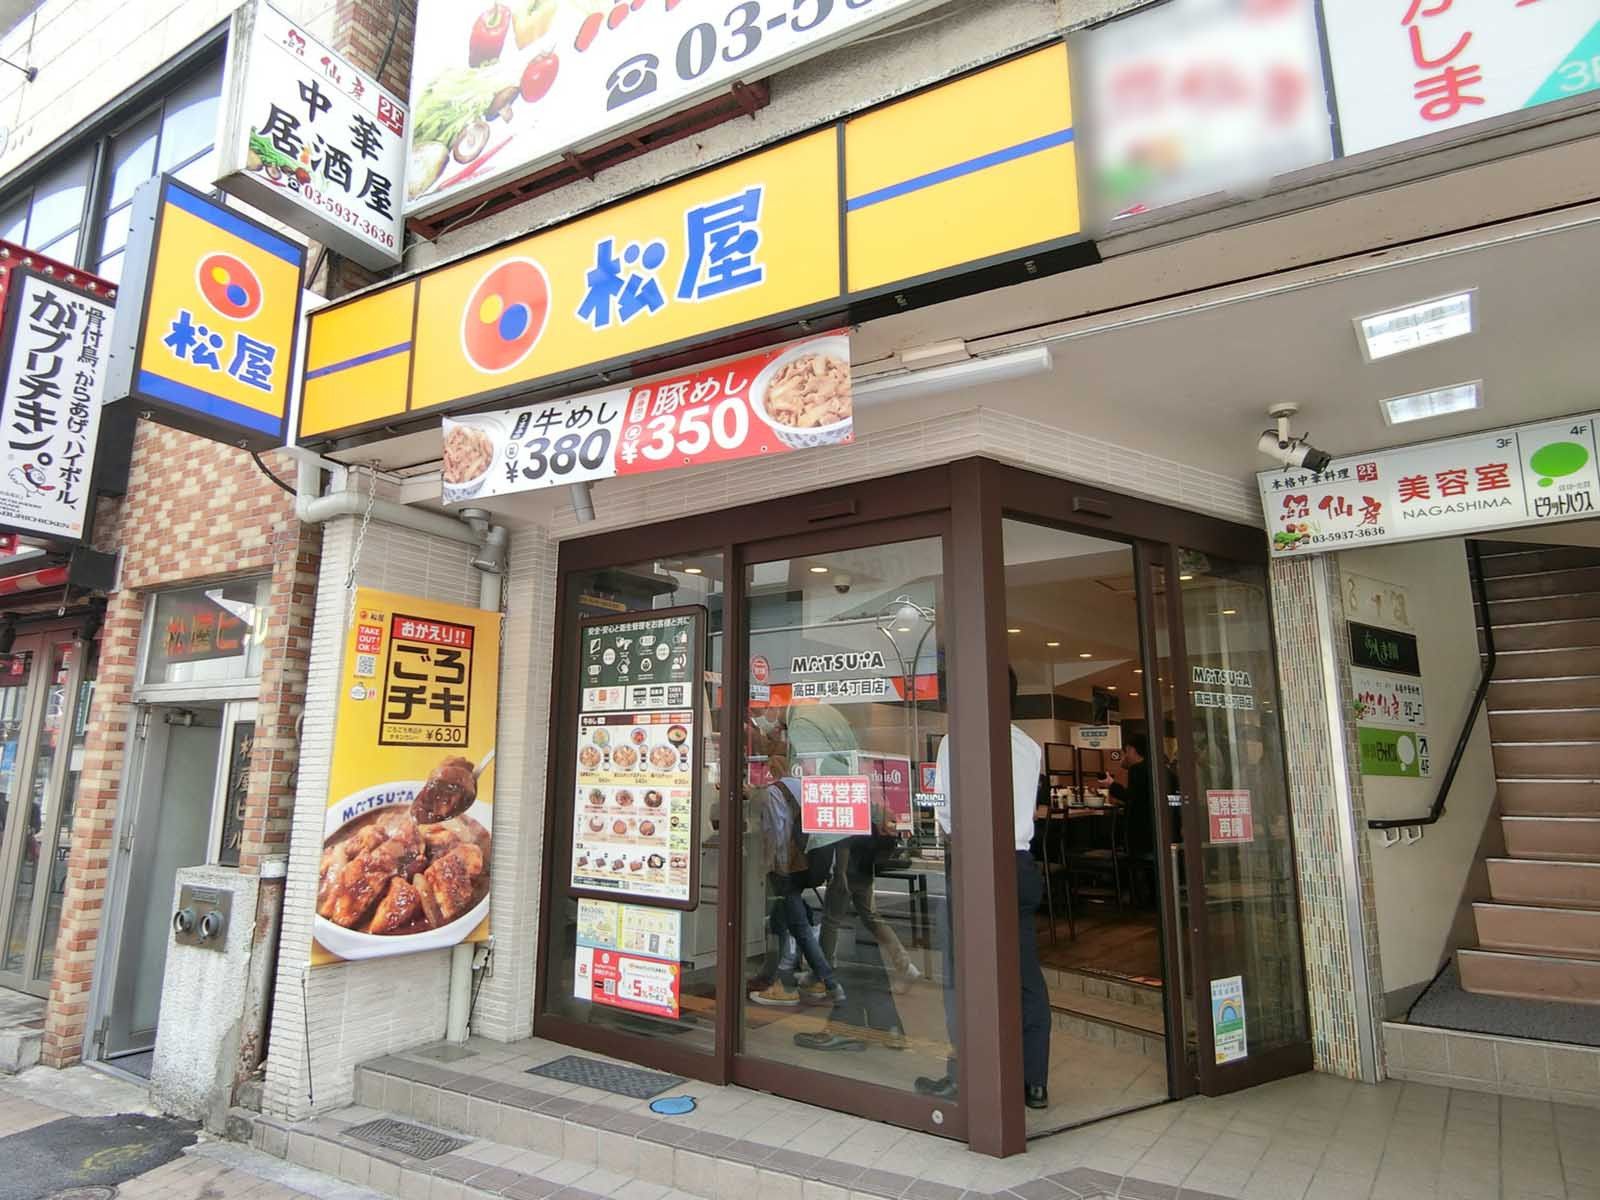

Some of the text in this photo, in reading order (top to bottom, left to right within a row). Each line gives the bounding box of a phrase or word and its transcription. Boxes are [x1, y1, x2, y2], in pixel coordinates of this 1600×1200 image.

[675, 0, 872, 81] 03-5
[297, 79, 385, 162] 中華
[379, 98, 404, 124] 2F
[258, 102, 394, 221] 居酒屋
[304, 186, 395, 248] 03-5937-3636
[577, 185, 764, 328] 松屋
[164, 311, 278, 392] 松屋
[8, 290, 84, 467] がブリチキン。
[651, 371, 748, 416] 豚めし
[533, 401, 619, 437] 牛めし
[621, 396, 750, 465] ¥350
[1569, 425, 1588, 435] 4F
[505, 428, 612, 484] ¥380
[1496, 438, 1513, 449] 3F
[1272, 467, 1350, 490] 本格中華料理
[1358, 463, 1376, 476] 2F
[1398, 463, 1512, 503] 美容室
[1402, 497, 1513, 519] NAGASHIMA
[1534, 491, 1595, 517] ピタットハウス
[1312, 527, 1385, 544] 03-5937-3636
[393, 644, 466, 685] ごろ
[792, 652, 884, 673] MATSUYA
[1194, 667, 1252, 687] MATSUYA
[388, 685, 465, 723] チキ
[793, 680, 885, 696] 高田馬場4丁目店
[426, 728, 462, 742] ¥630
[342, 790, 414, 822] MATSUYA
[804, 783, 869, 805] 通常営業
[816, 807, 855, 828] 再開
